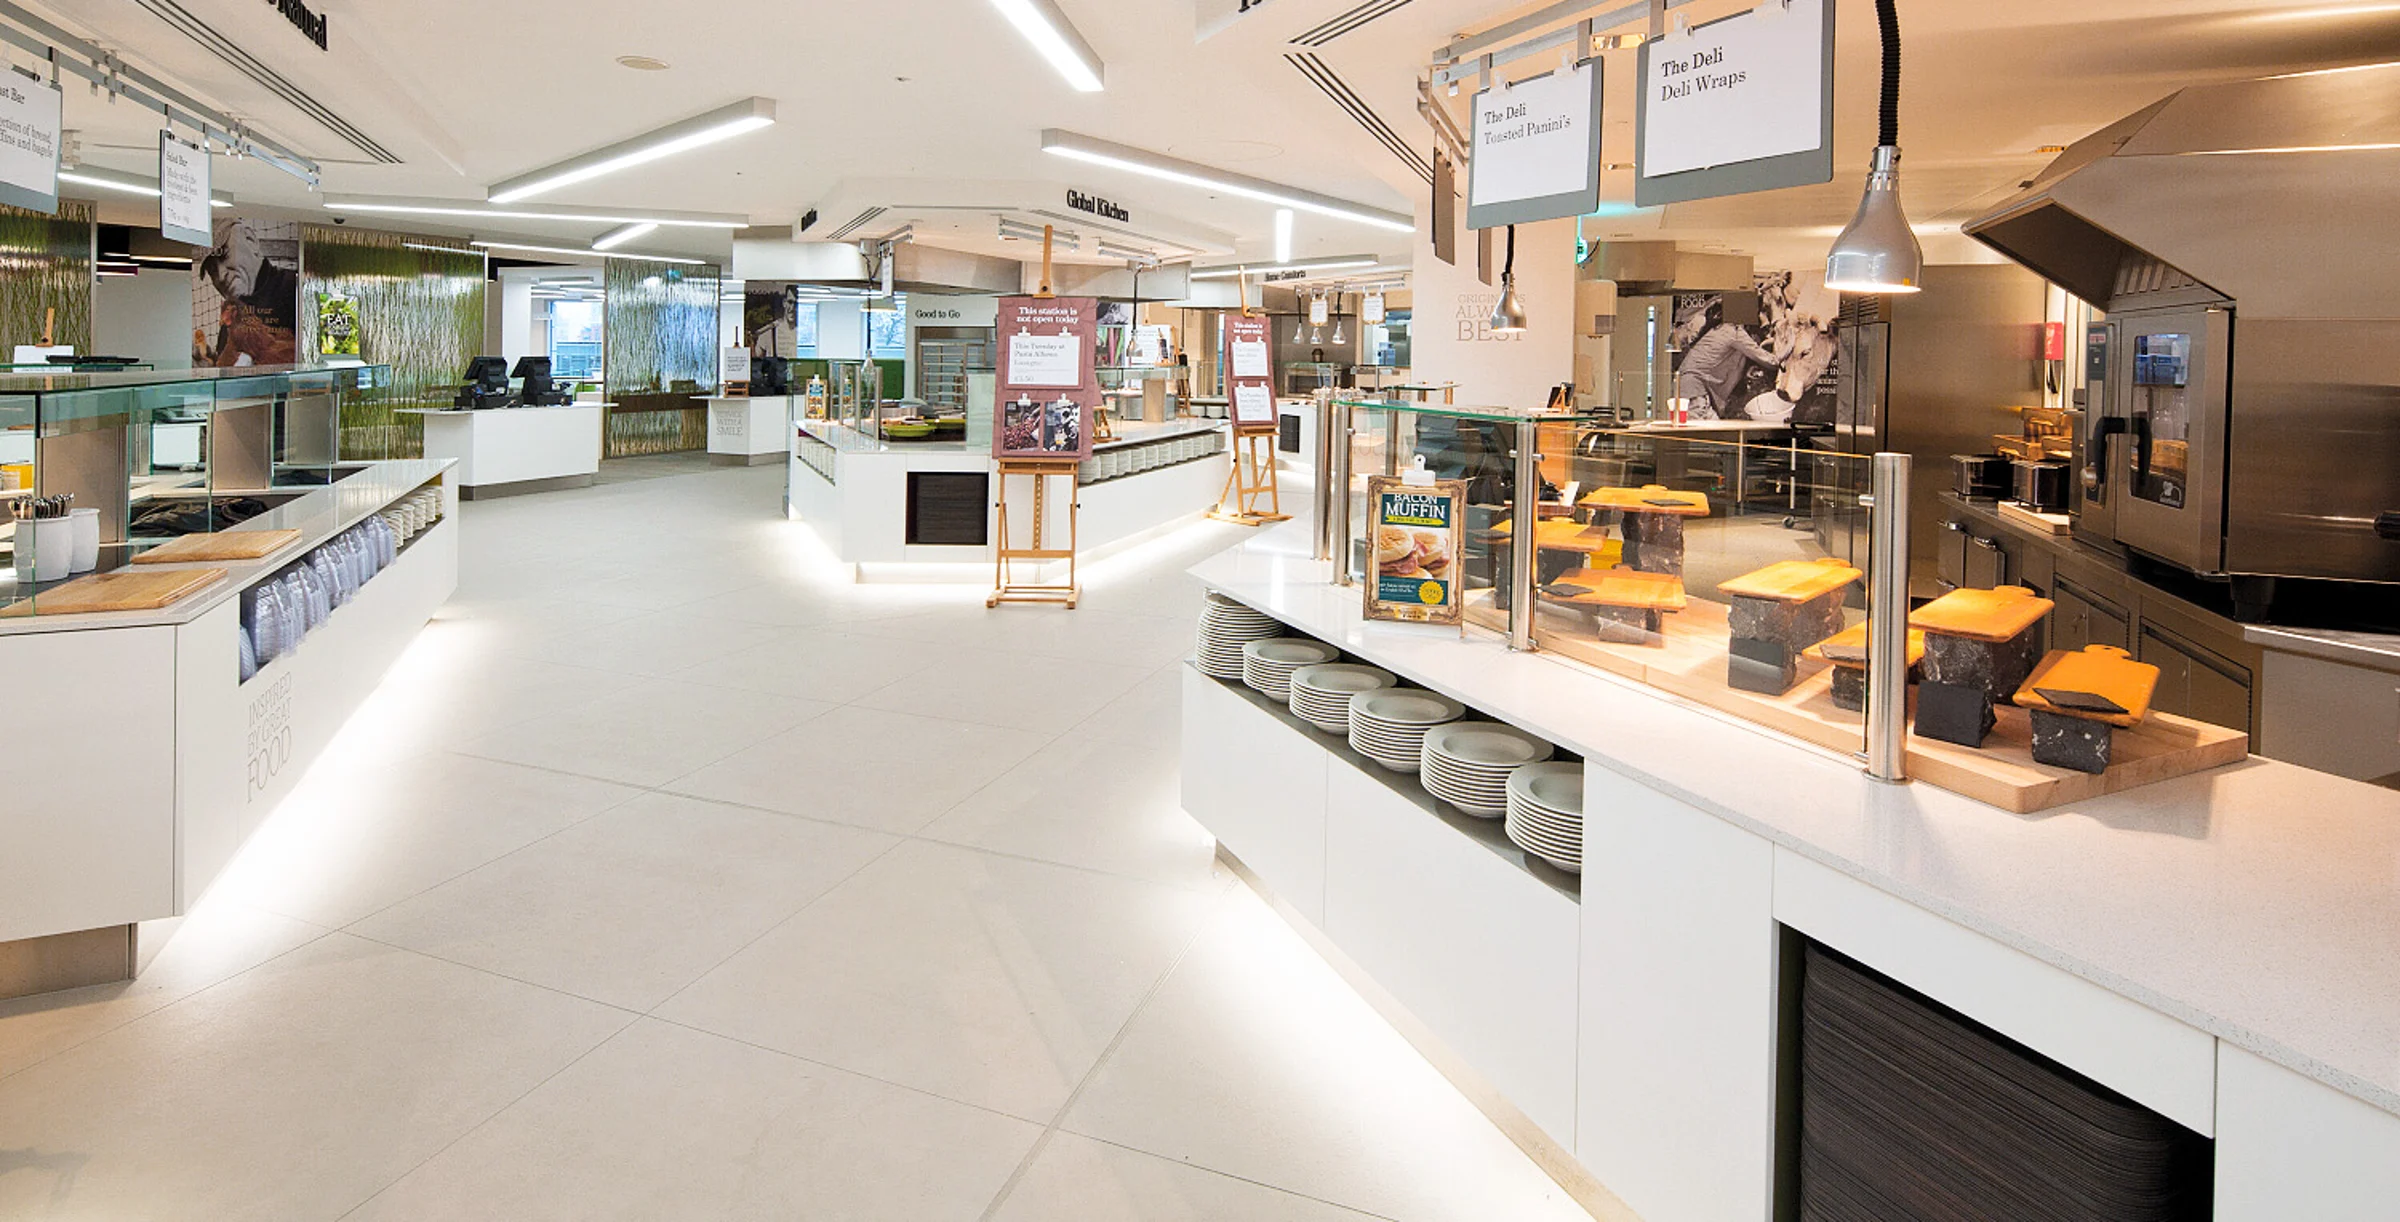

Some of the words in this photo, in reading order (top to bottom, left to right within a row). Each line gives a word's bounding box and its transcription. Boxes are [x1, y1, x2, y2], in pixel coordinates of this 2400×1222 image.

[1661, 60, 1689, 77] The
[1692, 46, 1723, 69] Deli
[1661, 79, 1691, 101] Deli
[1695, 71, 1747, 92] Wraps
[1484, 110, 1504, 124] The
[1505, 102, 1527, 119] Deli
[1484, 124, 1524, 144] Toasted
[1526, 114, 1571, 136] Panini's
[1066, 189, 1095, 213] Global
[1096, 197, 1129, 223] Kitchen
[326, 313, 350, 326] EAT
[915, 309, 937, 319] Good
[938, 310, 947, 318] to
[948, 309, 961, 318] Go
[1017, 315, 1031, 323] not
[1032, 316, 1054, 324] open
[1055, 315, 1079, 325] today
[1019, 306, 1037, 315] This
[1038, 307, 1068, 316] station
[1070, 307, 1078, 315] is
[716, 426, 743, 436] SMILE
[1385, 501, 1446, 519] MUFFIN
[1394, 493, 1438, 505] BACON
[249, 671, 292, 728] INSPIRED
[247, 725, 261, 758] BY
[261, 696, 292, 742] GREAT
[247, 725, 292, 803] FOOD
